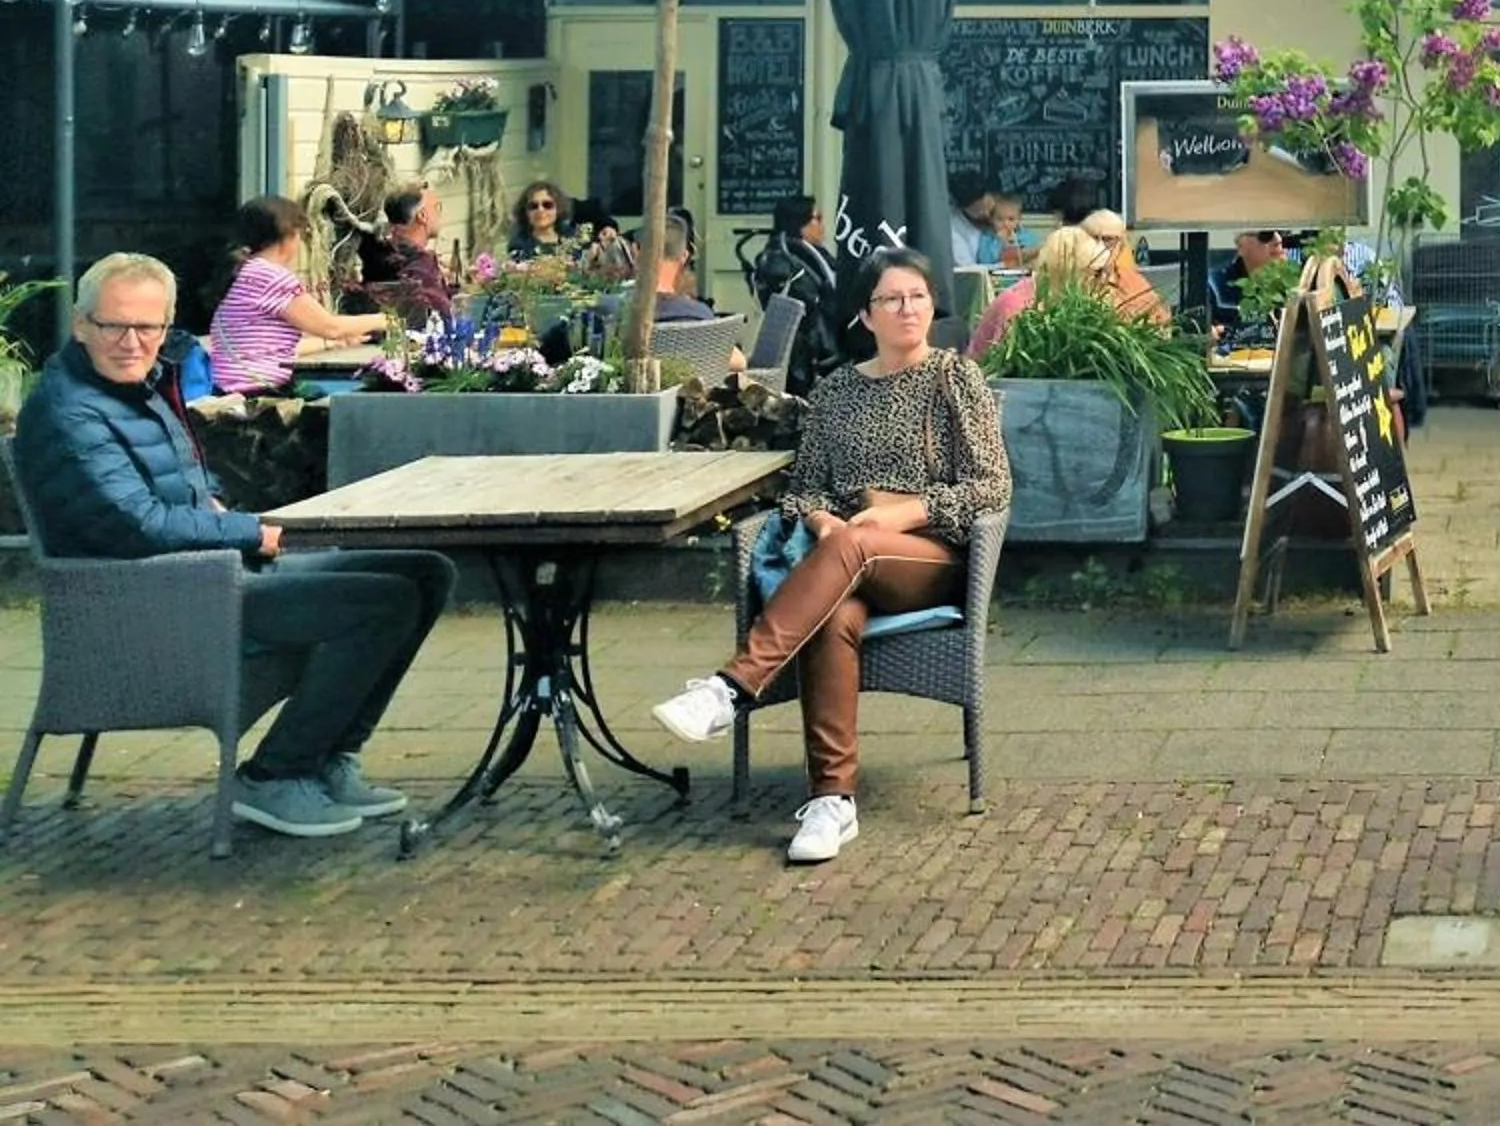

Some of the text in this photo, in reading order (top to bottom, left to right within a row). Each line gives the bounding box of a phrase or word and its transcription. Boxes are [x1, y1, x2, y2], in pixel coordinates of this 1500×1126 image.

[1005, 47, 1089, 65] DE BESTE
[1127, 46, 1194, 67] LUNCH
[1009, 141, 1079, 163] DINER
